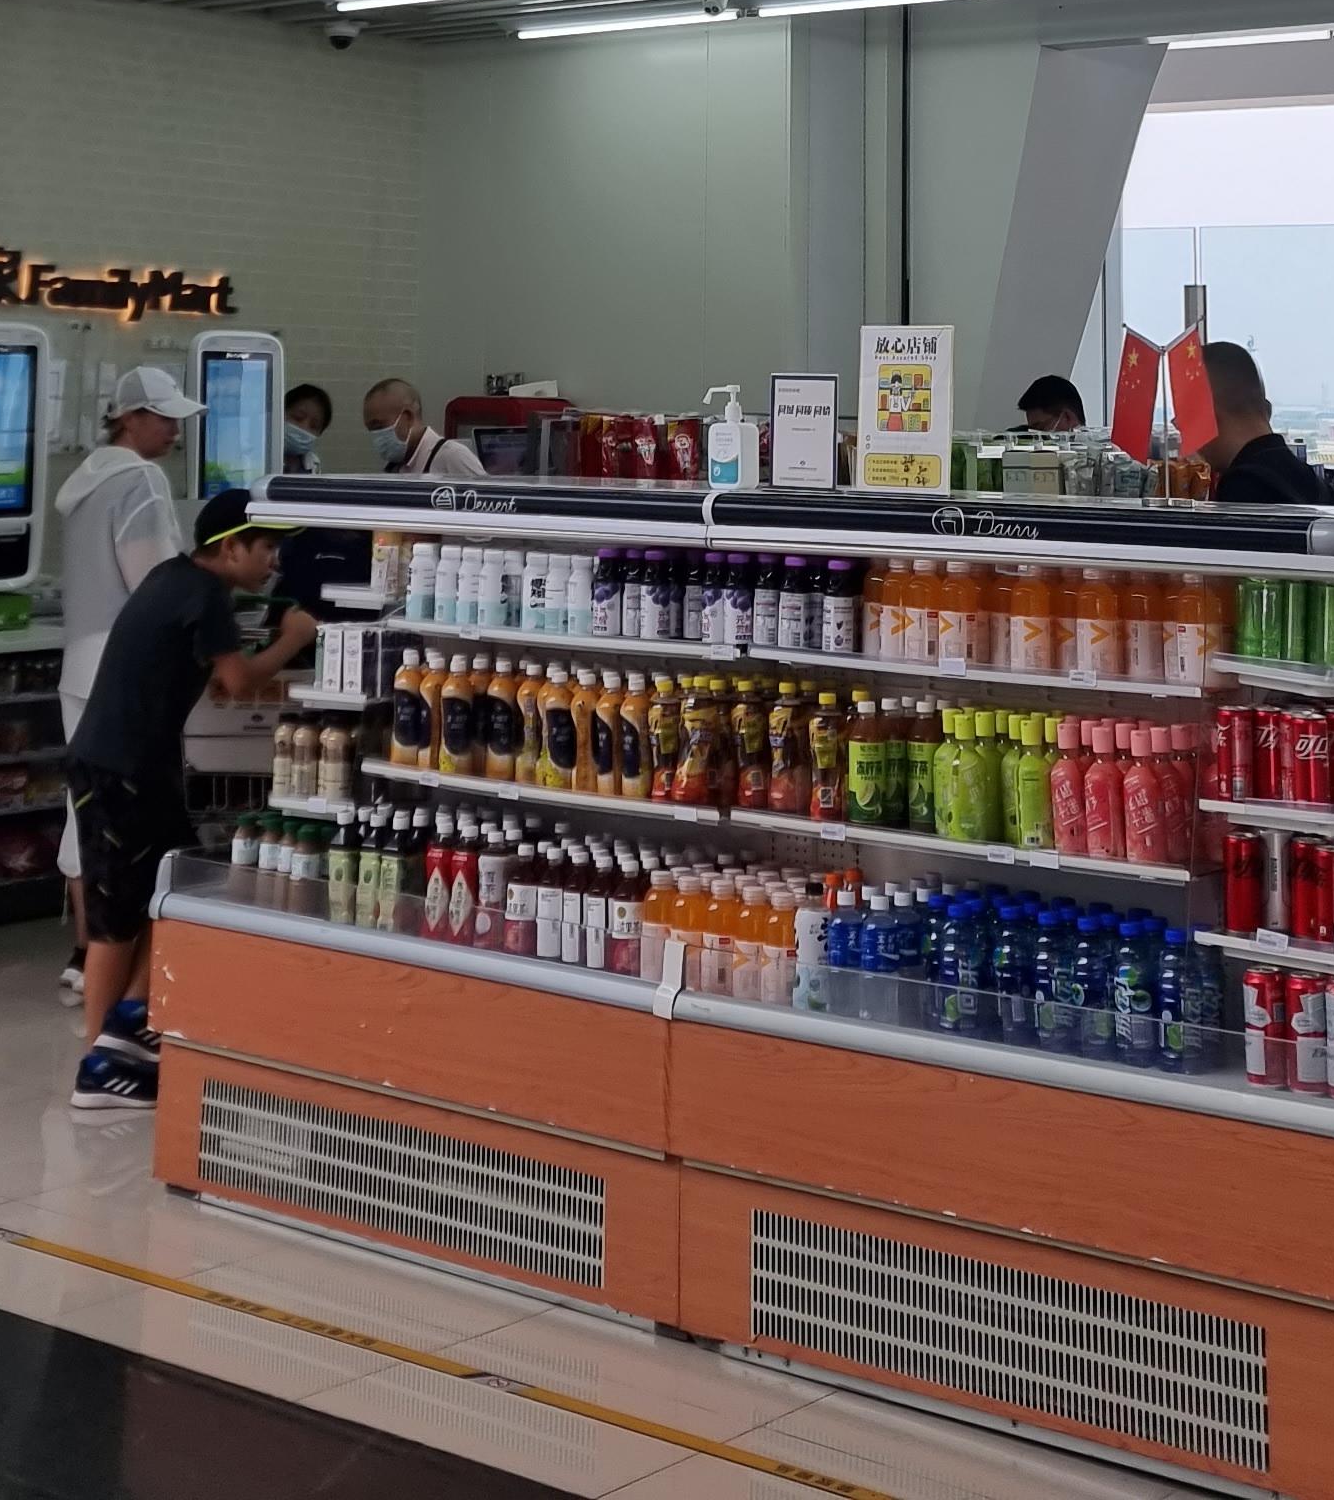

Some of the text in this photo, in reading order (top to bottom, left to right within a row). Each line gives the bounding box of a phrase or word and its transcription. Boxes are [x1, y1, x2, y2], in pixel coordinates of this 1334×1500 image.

[22, 264, 238, 322] FamilyMart
[875, 336, 938, 355] 放心店铺
[973, 510, 1040, 539] Dairy
